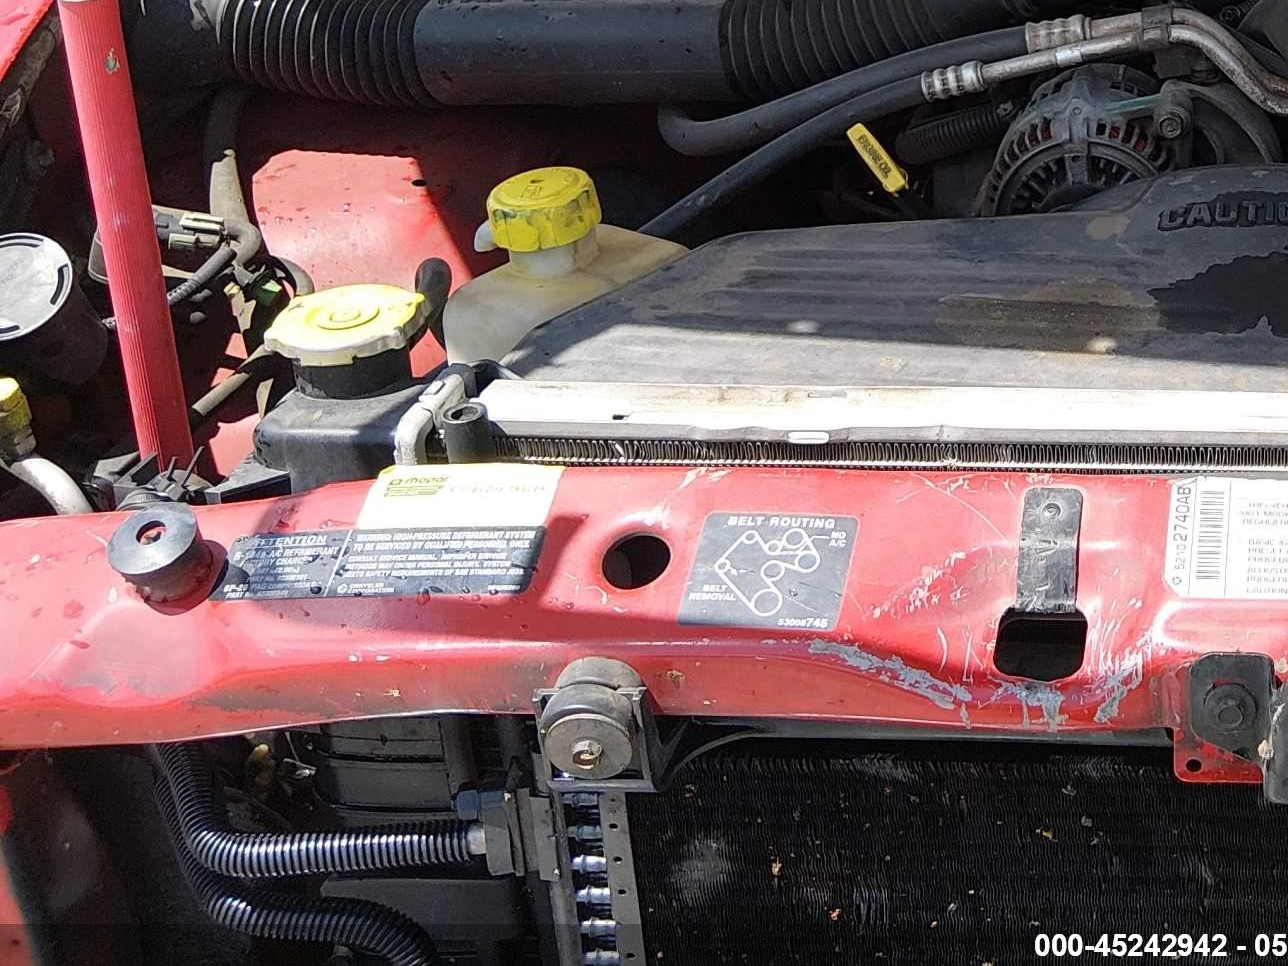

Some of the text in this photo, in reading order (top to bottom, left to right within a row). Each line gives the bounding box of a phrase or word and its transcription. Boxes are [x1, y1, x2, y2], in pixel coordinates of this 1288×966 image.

[856, 134, 883, 164] ENGINE
[728, 515, 836, 530] BELT ROUTING
[828, 538, 847, 548] A/C
[702, 584, 728, 592] BELT
[688, 591, 737, 601] REMOVAL
